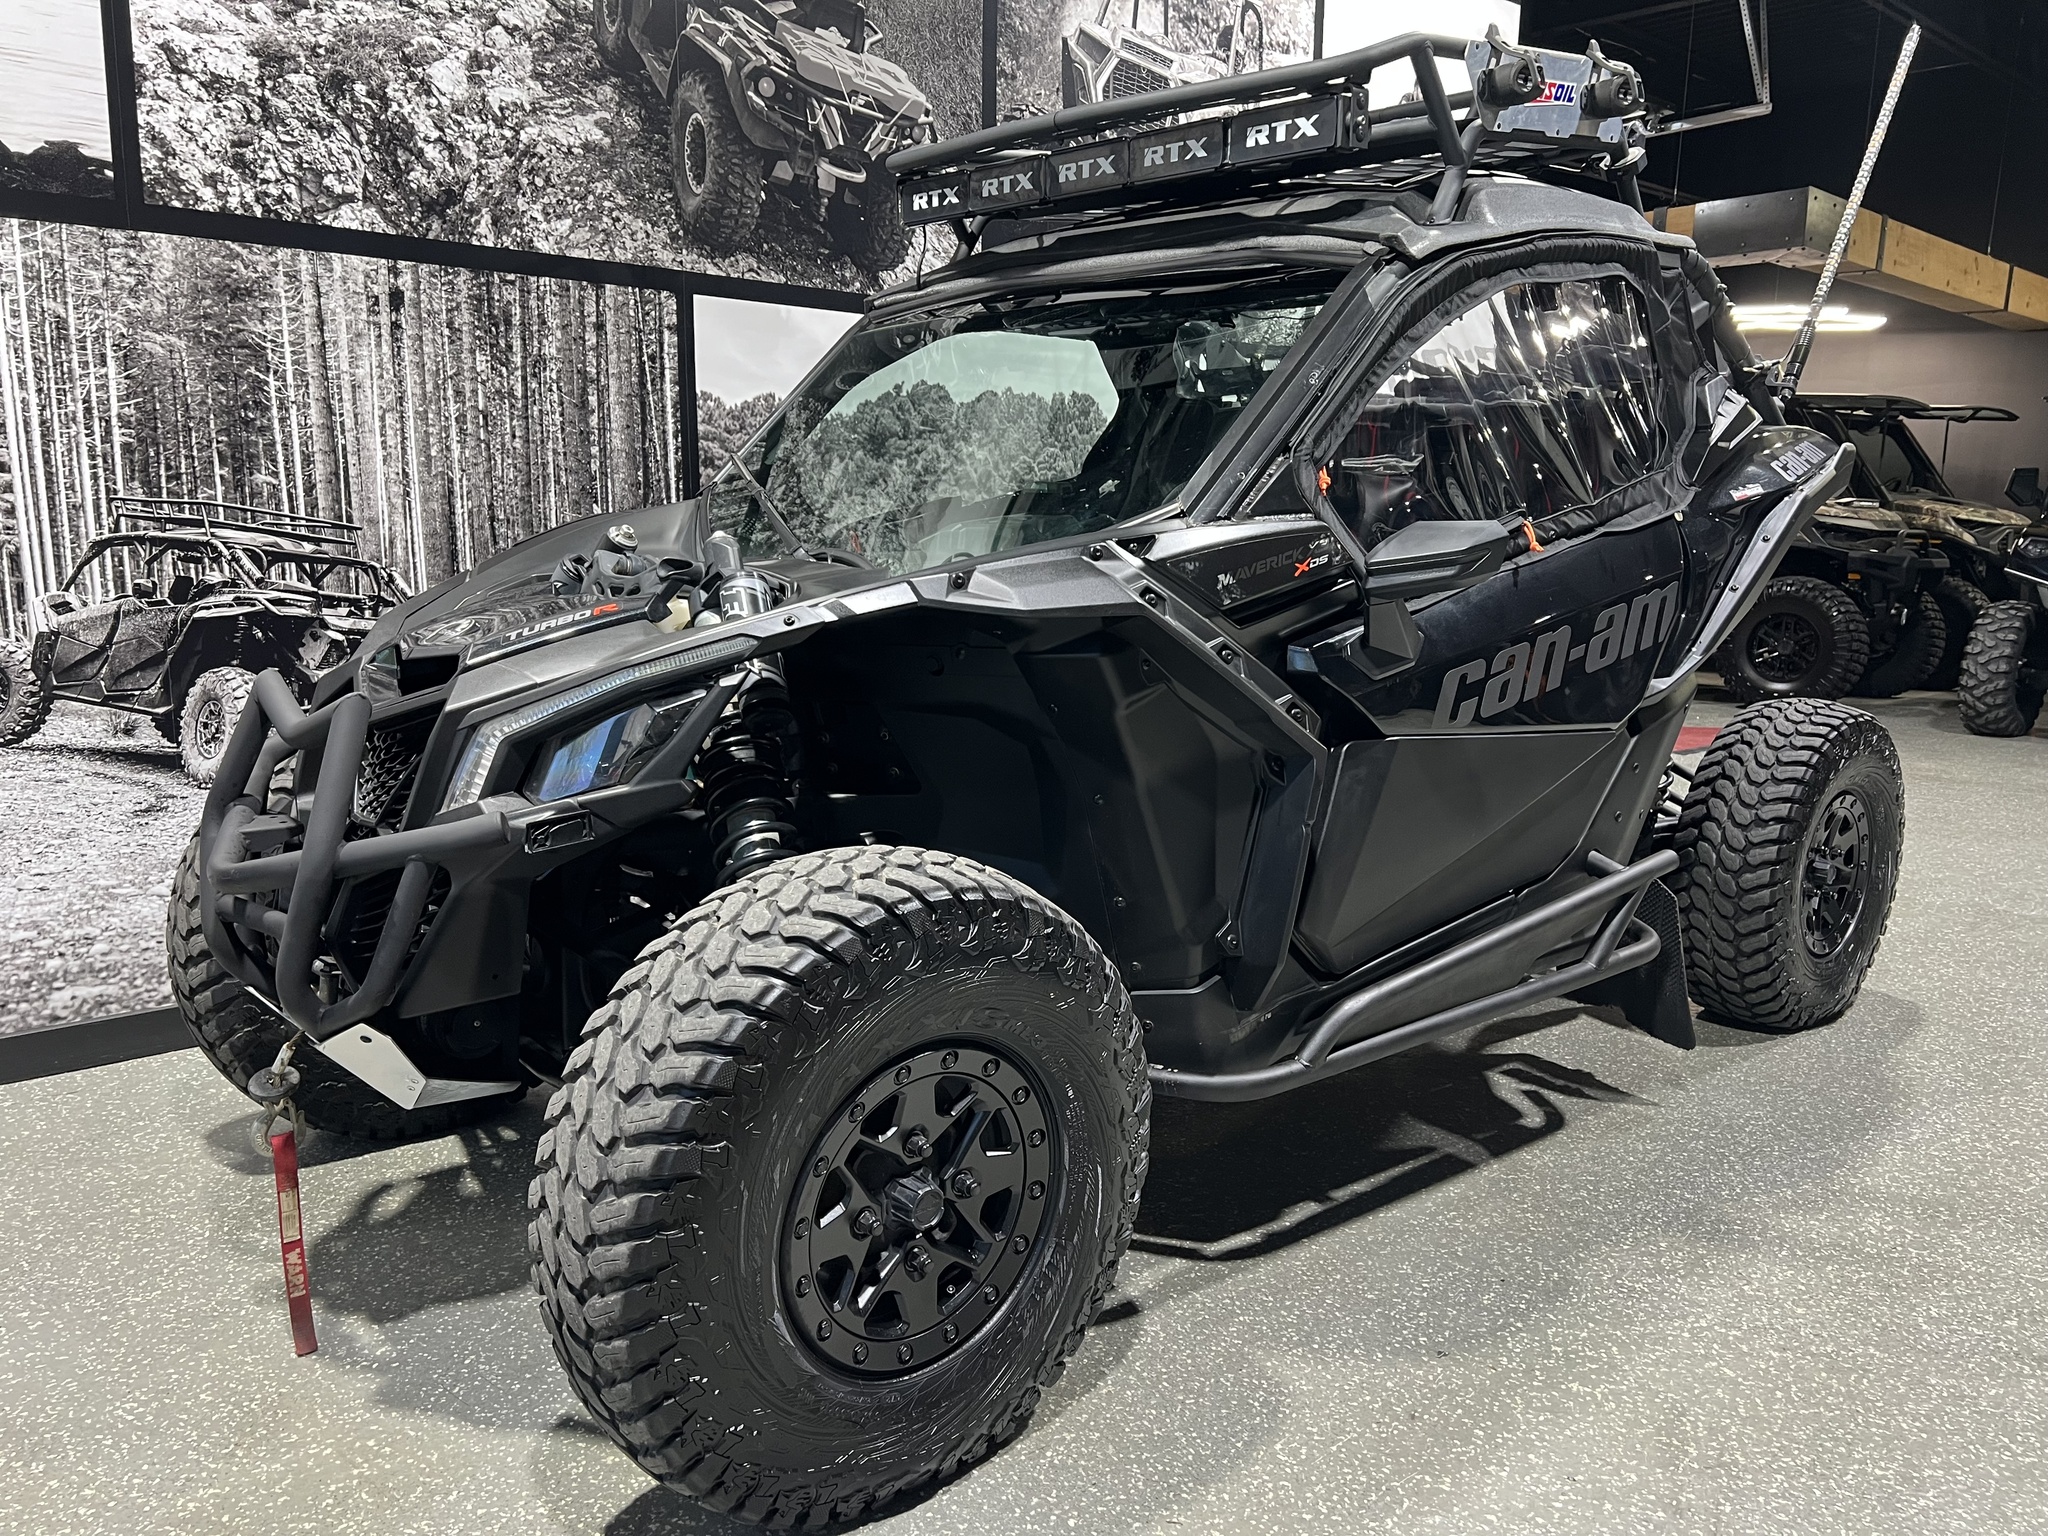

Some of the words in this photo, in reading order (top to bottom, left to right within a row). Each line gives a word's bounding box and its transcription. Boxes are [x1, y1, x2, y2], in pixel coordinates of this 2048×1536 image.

[1246, 113, 1320, 148] RTX
[1143, 136, 1208, 167] RTX
[981, 171, 1034, 198] RTX
[1058, 155, 1116, 183] RTX
[912, 186, 960, 211] RTX
[1216, 546, 1304, 590] MAVERICK
[284, 1247, 307, 1299] WARN
